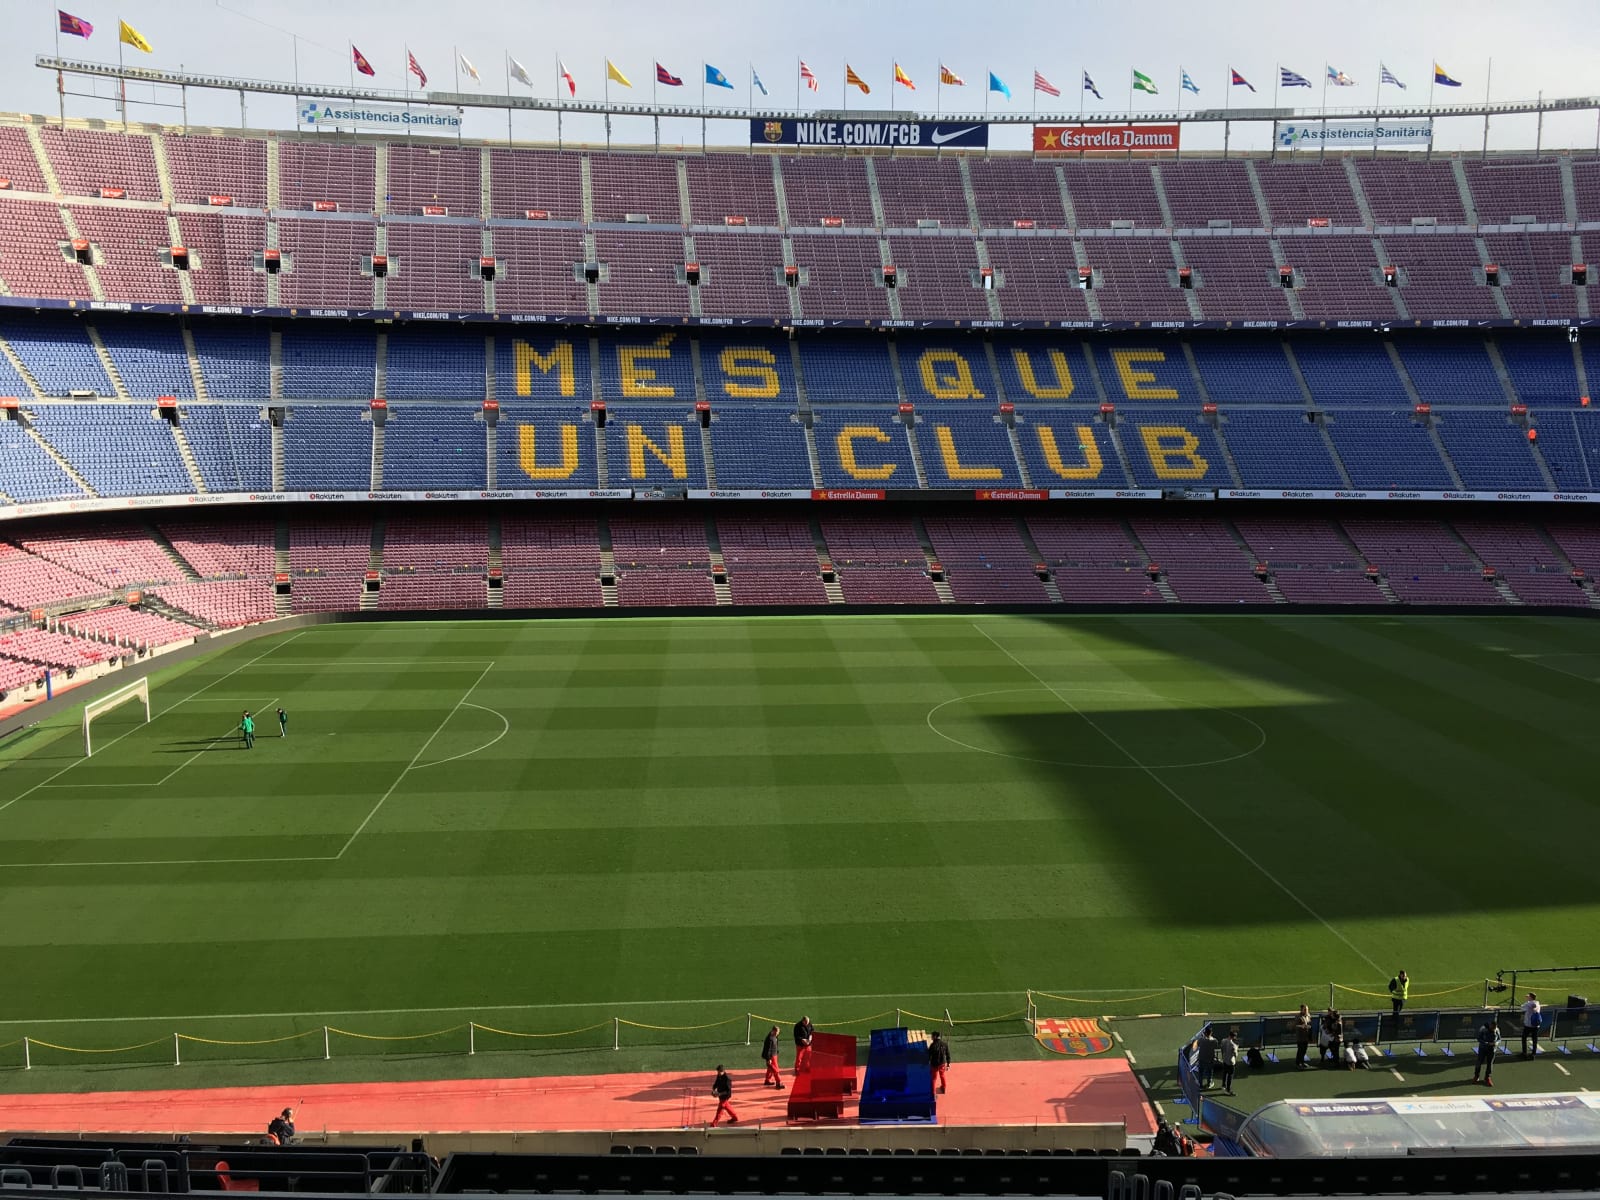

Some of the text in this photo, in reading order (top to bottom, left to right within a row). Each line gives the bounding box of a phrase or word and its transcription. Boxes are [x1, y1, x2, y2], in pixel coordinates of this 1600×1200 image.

[324, 107, 459, 126] Assistència Sanitària
[796, 122, 921, 145] NIKE.COM/FCB
[1060, 129, 1173, 147] Estrella Damm
[1301, 126, 1432, 139] Assistència Sanitària
[919, 347, 1179, 399] QUE
[518, 421, 1209, 480] UN CLUB
[255, 493, 285, 501] Rakuten
